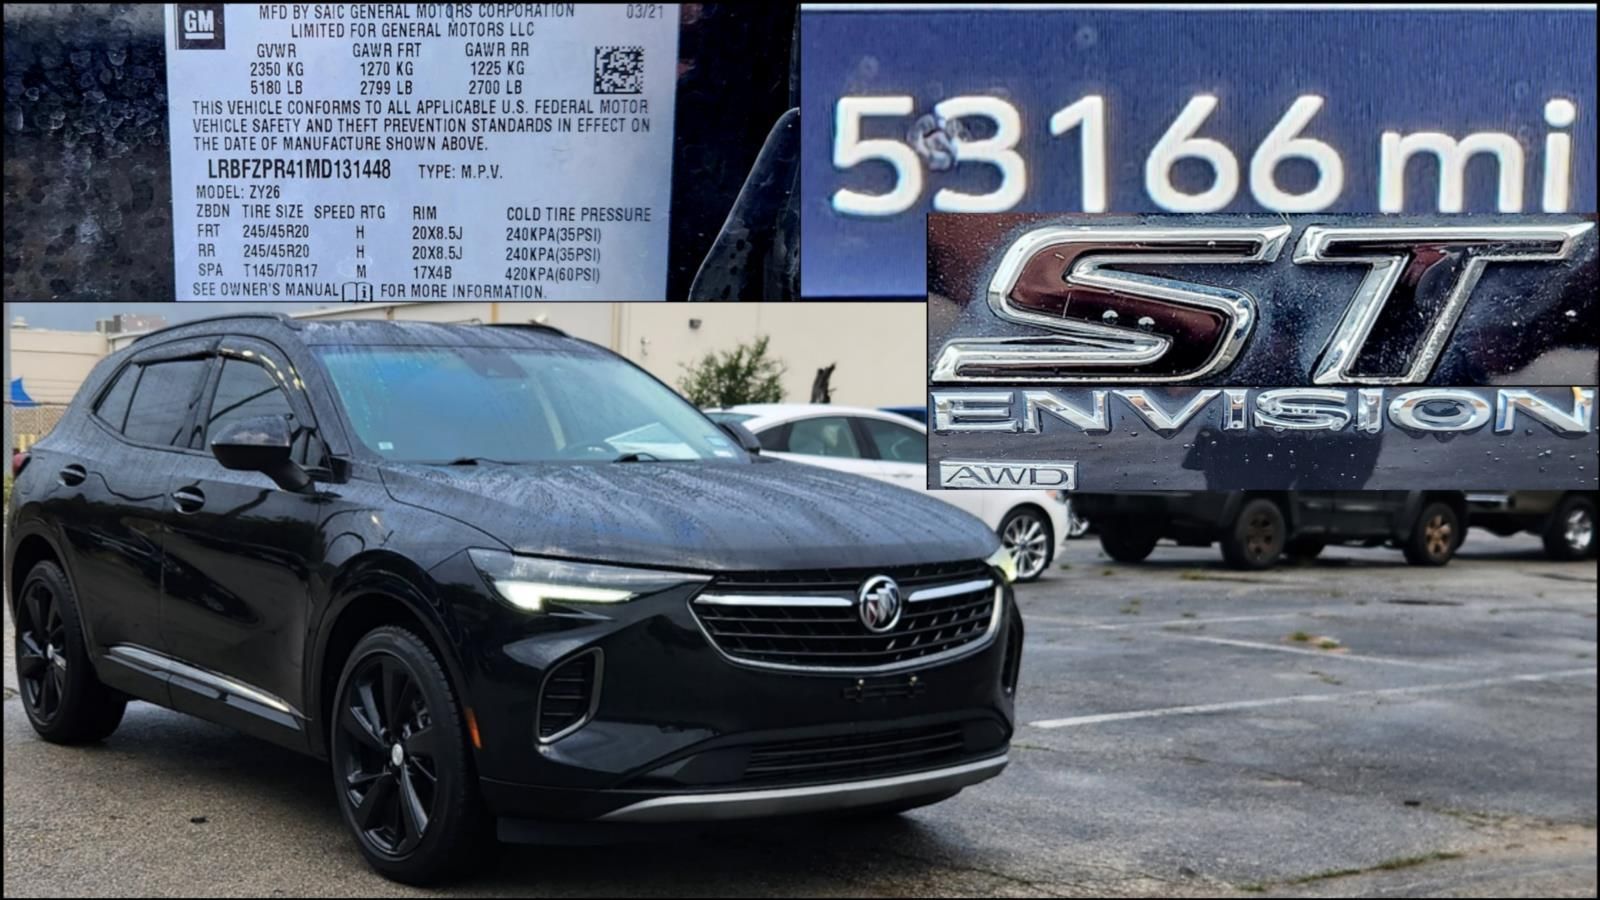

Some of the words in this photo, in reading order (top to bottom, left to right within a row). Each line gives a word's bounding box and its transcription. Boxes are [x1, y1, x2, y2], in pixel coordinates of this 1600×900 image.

[260, 5, 287, 20] MFD
[293, 5, 308, 19] BY
[314, 4, 344, 19] SAIC
[351, 4, 410, 19] GENERAL
[417, 4, 472, 19] MOTORS
[479, 3, 575, 18] CORPORATION
[626, 4, 664, 19] 03/21
[184, 10, 214, 33] GM
[292, 24, 344, 38] LIMITED
[351, 23, 376, 37] FOR
[382, 22, 441, 37] GENERAL
[448, 22, 504, 37] MOTORS
[510, 22, 535, 36] LLC
[257, 44, 297, 58] GVWR
[353, 43, 392, 58] GAWR
[398, 42, 422, 58] FRT
[465, 42, 505, 57] GAWR
[511, 42, 530, 57] RR
[250, 63, 281, 76] 2350
[287, 63, 304, 76] KG
[360, 62, 390, 76] 1270
[396, 62, 413, 76] KG
[471, 61, 501, 76] 1225
[507, 61, 525, 76] KG
[251, 80, 281, 95] 5180
[287, 80, 303, 95] LB
[360, 80, 391, 95] 2799
[397, 80, 413, 95] LB
[469, 80, 500, 94] 2700
[506, 80, 522, 94] LB
[193, 101, 223, 115] THIS
[227, 101, 282, 115] VEHICLE
[288, 100, 361, 115] CONFORMS
[366, 100, 381, 114] TO
[388, 100, 411, 114] ALL
[417, 100, 496, 114] APPLICABLE
[502, 100, 528, 114] U.S.
[535, 100, 594, 114] FEDERAL
[600, 100, 648, 113] MOTOR
[193, 119, 247, 133] VEHICLE
[252, 119, 301, 132] SAFETY
[306, 119, 333, 132] AND
[337, 119, 379, 132] THEFT
[384, 118, 466, 133] PREVENTION
[472, 118, 552, 133] STANDARDS
[558, 118, 572, 132] IN
[577, 118, 626, 132] EFFECT
[631, 119, 650, 132] ON
[193, 137, 219, 151] THE
[224, 137, 256, 151] DATE
[261, 137, 277, 150] OF
[283, 137, 381, 150] MANUFACTURE
[386, 136, 436, 150] SHOWN
[442, 136, 488, 151] ABOVE.
[831, 94, 1344, 216] 53166
[1379, 98, 1576, 214] mi
[208, 159, 391, 179] LRBFZPR41MD131448
[418, 164, 456, 179] TYPE:
[461, 164, 503, 179] M.P.V.
[196, 185, 244, 199] MODEL:
[250, 185, 280, 199] ZY26
[196, 204, 230, 218] ZBDN
[242, 204, 271, 218] TIRE
[276, 205, 304, 218] SIZE
[314, 205, 355, 219] SPEED
[361, 205, 385, 219] RTG
[413, 206, 437, 220] RIM
[507, 207, 541, 221] COLD
[547, 207, 575, 221] TIRE
[581, 207, 651, 222] PRESSURE
[198, 224, 220, 238] FRT
[243, 224, 310, 239] 245/45R20
[356, 225, 364, 239] H
[412, 226, 462, 240] 20X8.5J
[506, 227, 601, 244] 240KPA(35PSI)
[199, 243, 216, 257] RR
[243, 244, 310, 258] 245/45R20
[356, 245, 365, 258] H
[412, 246, 462, 260] 20X8.5J
[506, 247, 601, 263] 240KPA(35PSI)
[198, 263, 223, 277] SPA
[244, 264, 318, 278] T145/70R17
[357, 265, 366, 278] M
[413, 266, 452, 280] 17X4B
[505, 268, 600, 284] 420KPA(60PSI)
[193, 283, 216, 296] SEE
[221, 283, 280, 296] OWNER'S
[286, 283, 339, 297] MANUAL
[381, 284, 405, 297] FOR
[411, 284, 448, 298] MORE
[453, 285, 547, 299] INFORMATION.
[931, 222, 1595, 384] ST
[931, 388, 1594, 434] ENVISION
[944, 466, 1072, 488] AWD
